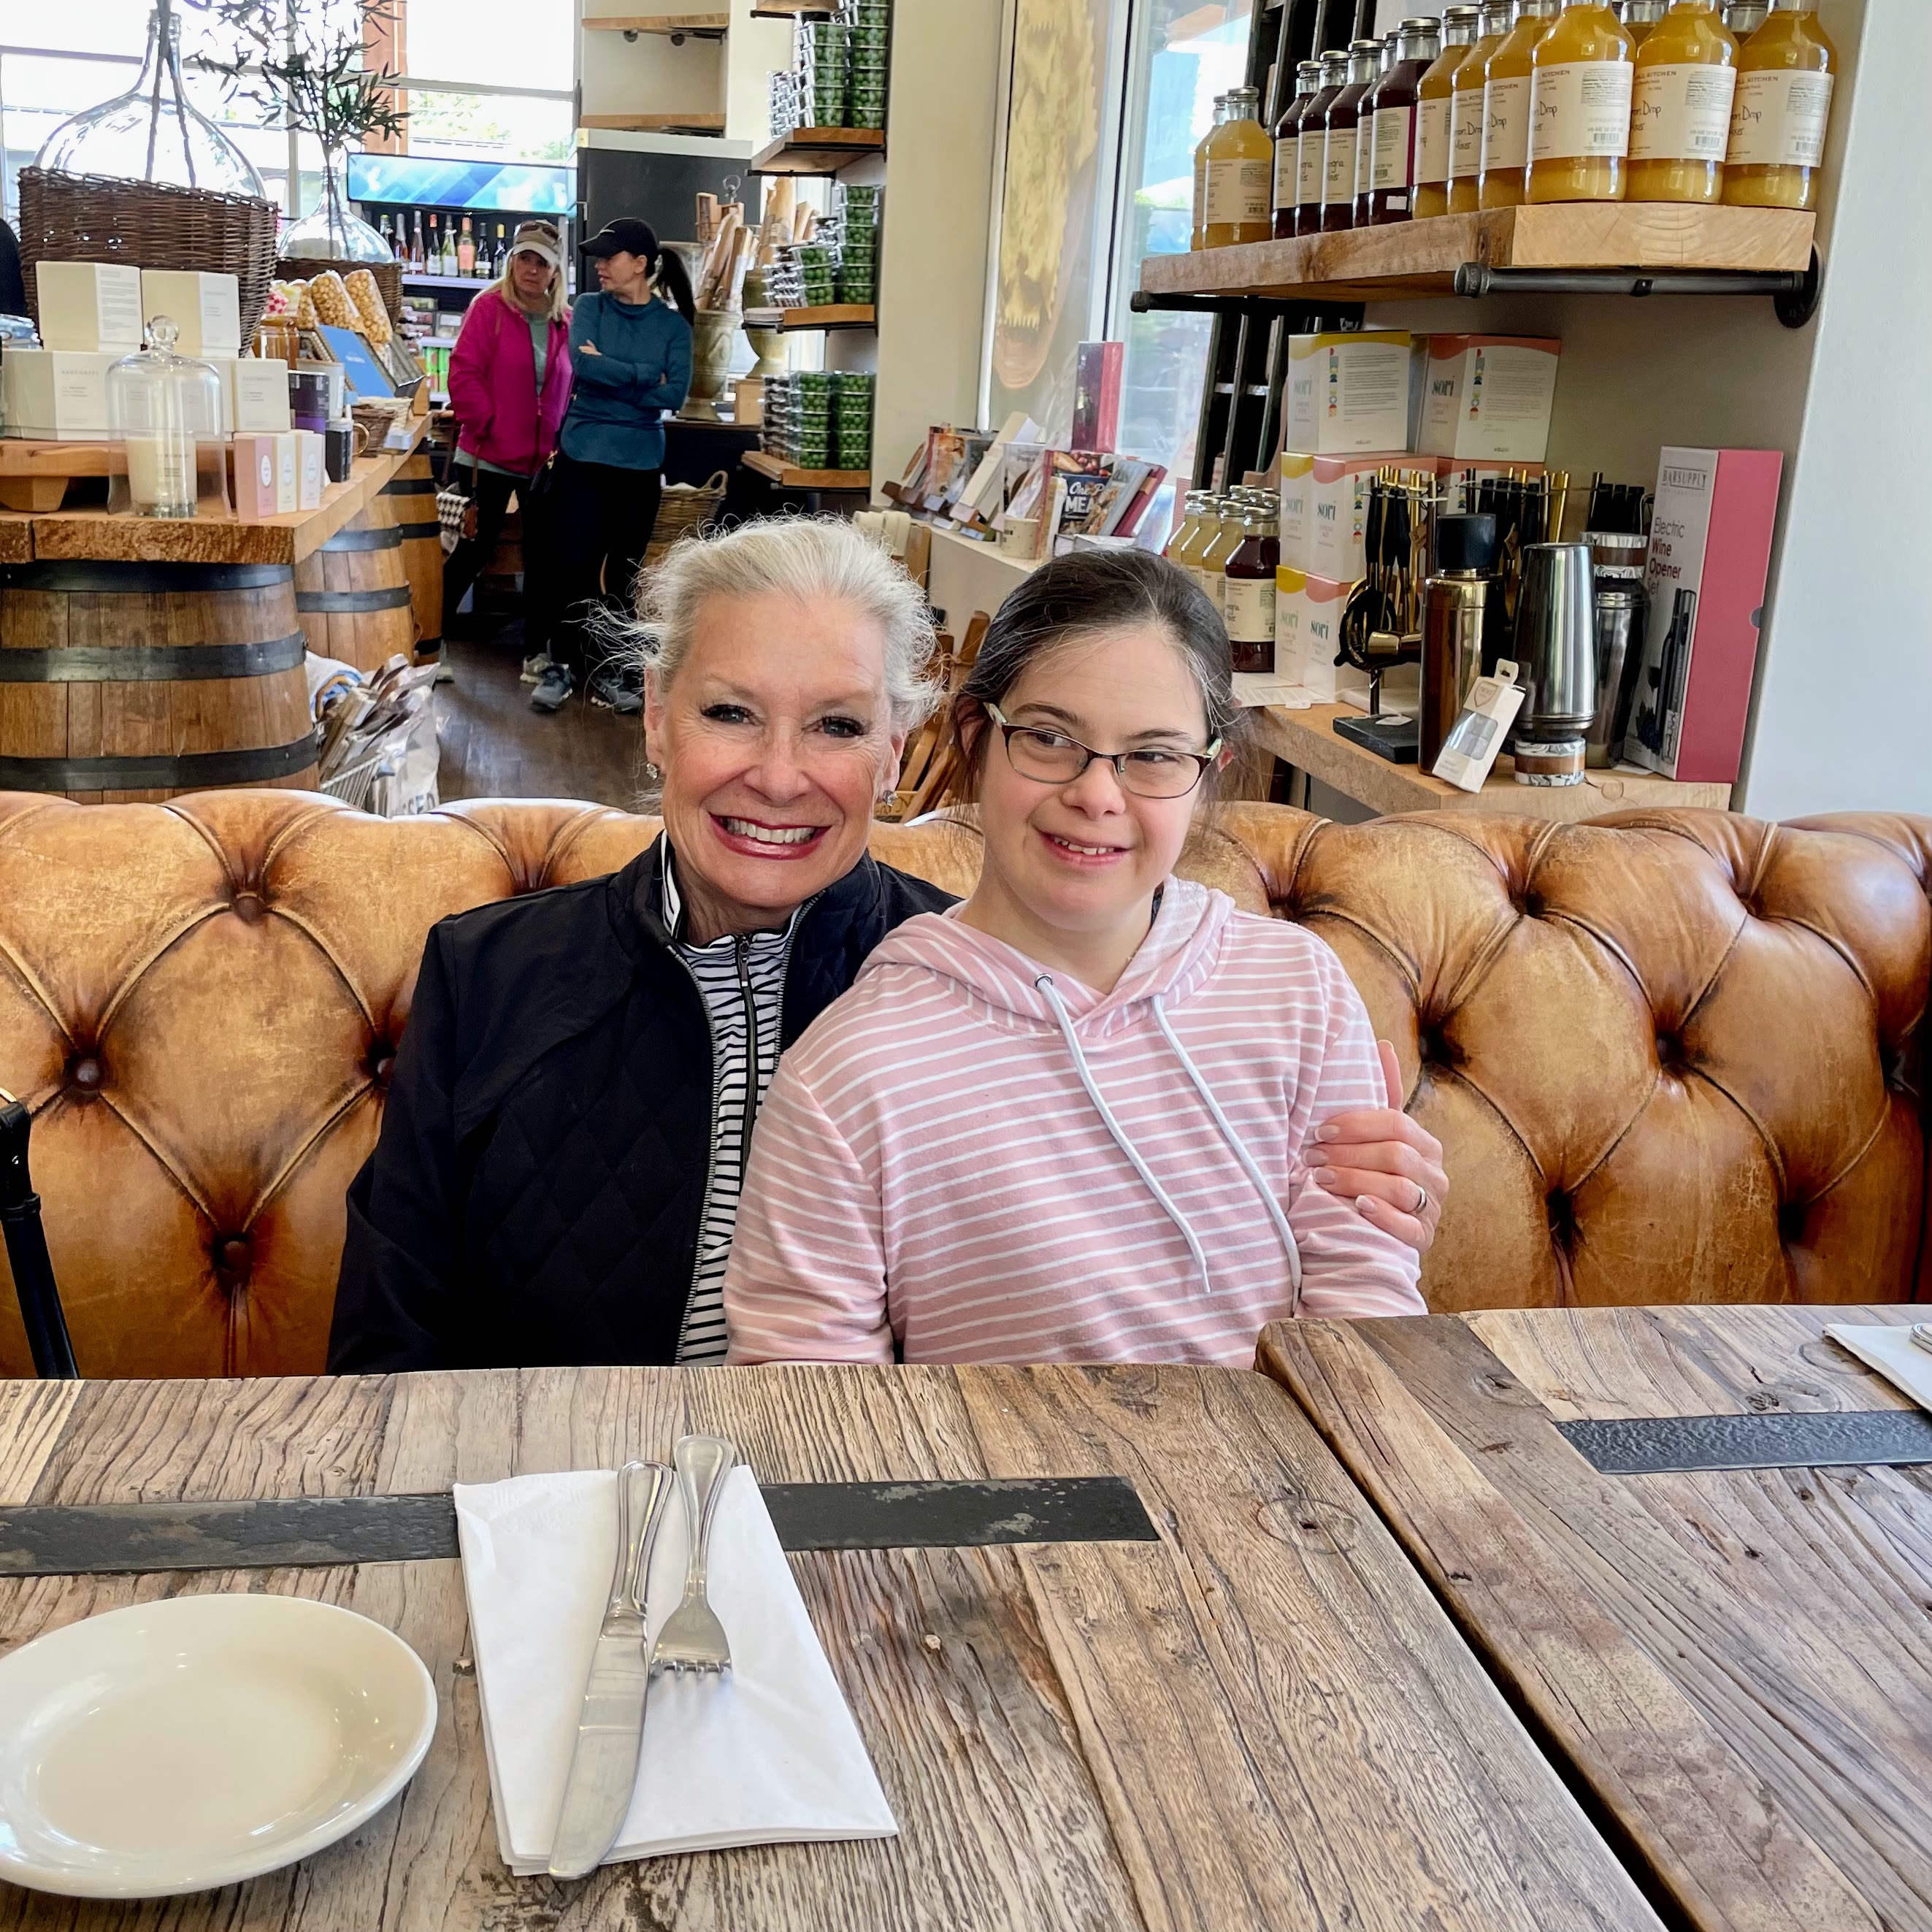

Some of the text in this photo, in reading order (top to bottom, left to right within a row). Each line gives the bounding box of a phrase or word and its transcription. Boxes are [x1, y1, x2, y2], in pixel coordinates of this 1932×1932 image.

[1541, 70, 1571, 78] KITCHEN
[1539, 101, 1557, 118] Drop
[1642, 100, 1662, 119] Drop
[1742, 105, 1762, 123] Drop
[1490, 112, 1507, 130] Drop
[1654, 516, 1685, 539] Electric
[1652, 537, 1672, 557] Wine
[1649, 557, 1682, 579] Opener
